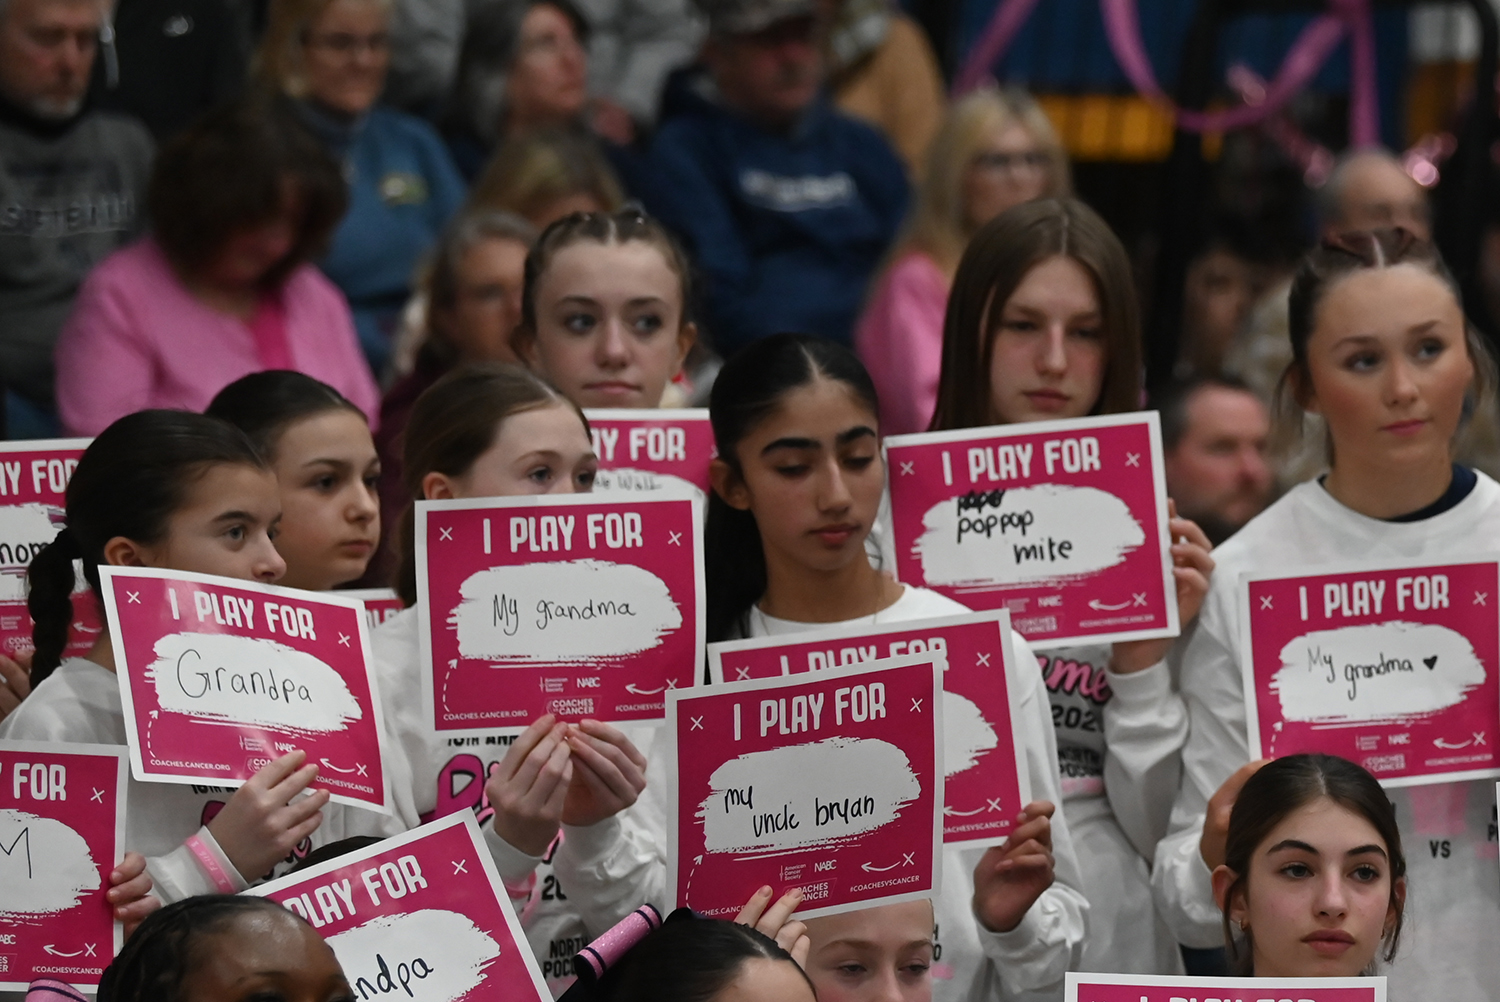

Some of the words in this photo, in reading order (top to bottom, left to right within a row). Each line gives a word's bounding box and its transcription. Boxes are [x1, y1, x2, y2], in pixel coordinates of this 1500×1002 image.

[629, 427, 686, 462] FOR
[942, 451, 953, 485] I
[967, 443, 1034, 483] PLAY
[1043, 436, 1102, 475] FOR
[483, 518, 492, 554] I
[510, 514, 575, 553] PLAY
[587, 512, 644, 549] FOR
[169, 588, 180, 620] I
[199, 590, 255, 635] PLAY
[264, 602, 317, 642] FOR
[493, 594, 519, 636] My
[536, 593, 637, 631] grandma
[1299, 584, 1310, 622] I
[1323, 579, 1394, 619] PLAY
[1396, 574, 1451, 611] FOR
[177, 648, 313, 704] Grandpa
[1306, 646, 1336, 684] My
[1343, 653, 1415, 701] grandma
[443, 709, 529, 721] COACHES.CANCER.ORG
[733, 704, 742, 741] I
[760, 694, 826, 738] PLAY
[834, 682, 887, 722] FOR
[13, 762, 68, 802] FOR
[150, 758, 231, 772] COACHES.CANCER.ORG
[753, 804, 801, 838] uncle
[814, 794, 876, 830] bryan
[814, 859, 838, 873] NABC
[1429, 840, 1452, 859] VS
[364, 854, 429, 909] FOR
[849, 874, 921, 893] #COACHESVSCANCER
[32, 965, 104, 975] #COACHESVSCANCER
